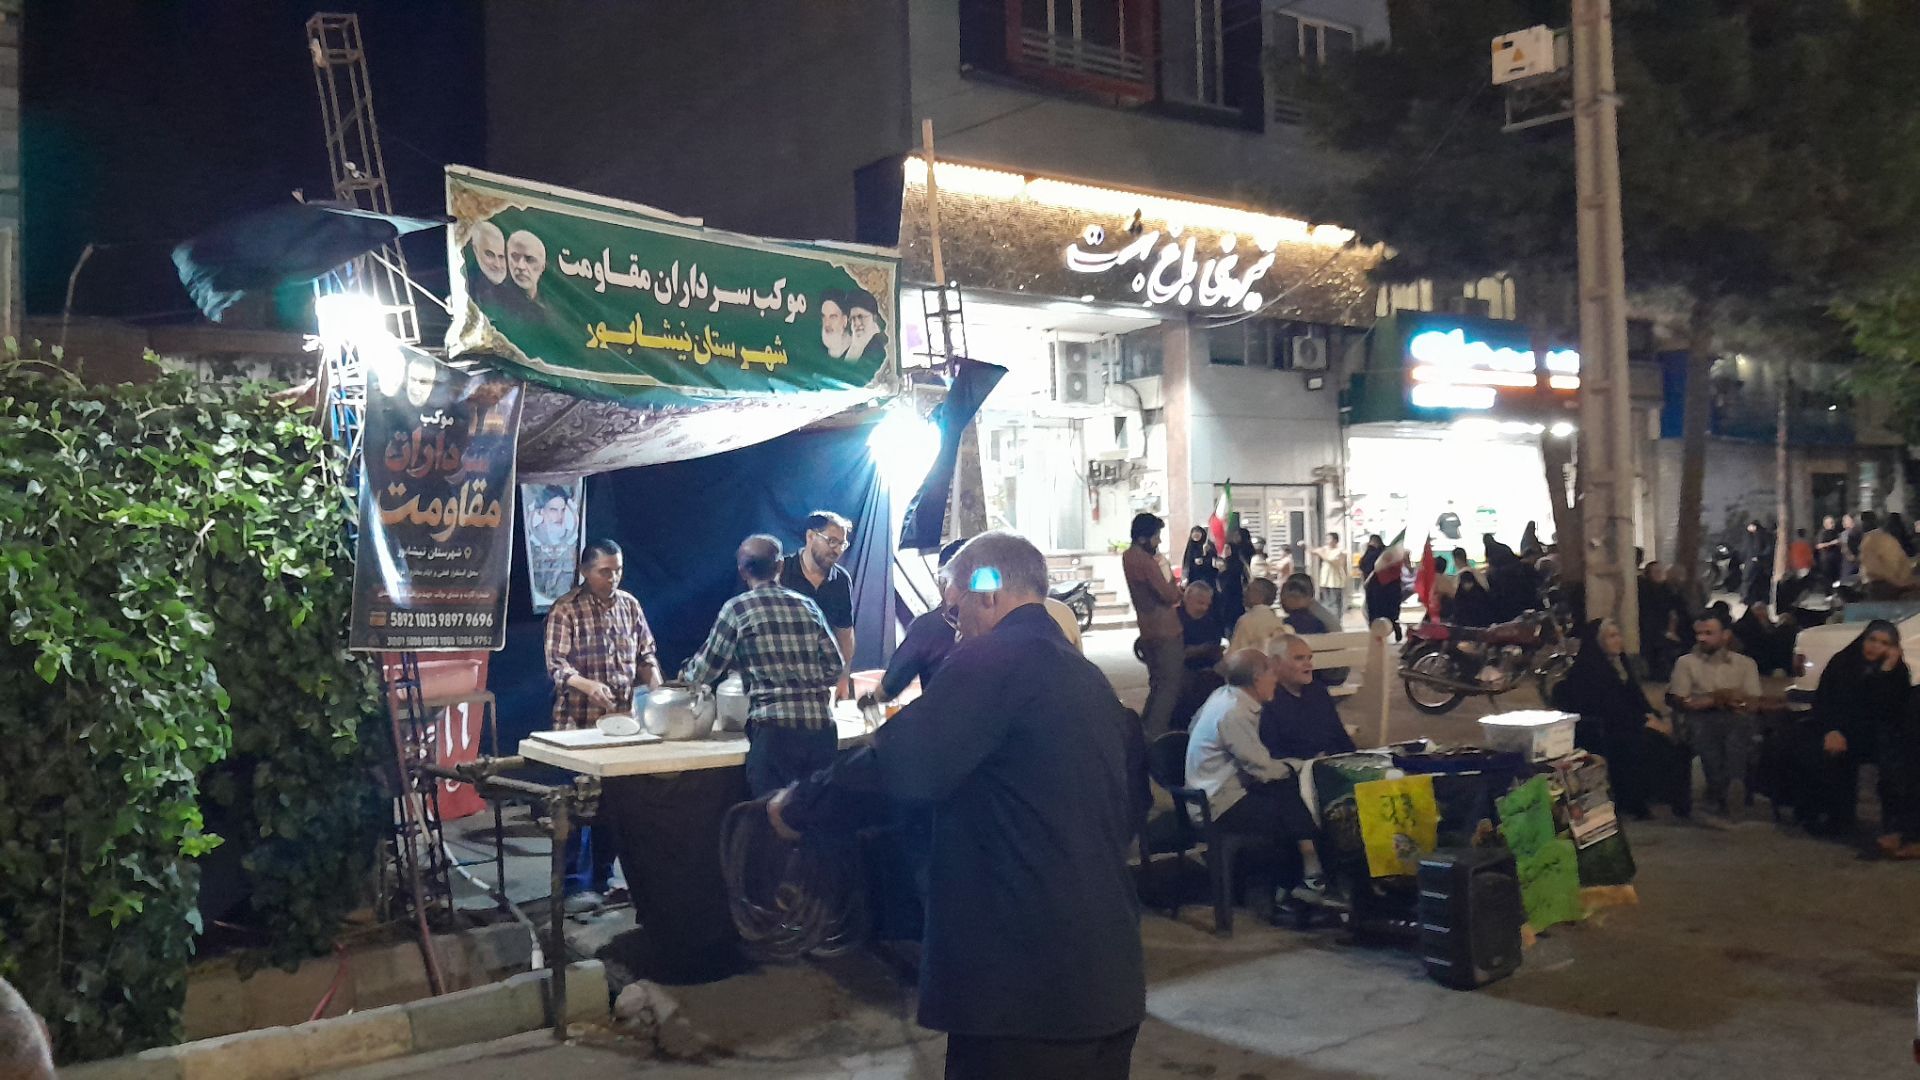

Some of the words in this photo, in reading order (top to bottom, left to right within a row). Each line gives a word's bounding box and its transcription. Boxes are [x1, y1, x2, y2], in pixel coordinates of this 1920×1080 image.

[557, 247, 652, 293] مقاومت
[653, 259, 752, 313] سرداران
[751, 278, 808, 324] موکب
[585, 312, 693, 361] نیشابور
[693, 325, 789, 371] شهرستان
[419, 409, 454, 430] موکب
[376, 479, 502, 542] مقاومت
[427, 546, 462, 560] شهرستان
[390, 612, 414, 627] 5892
[415, 613, 437, 627] 1013
[438, 613, 464, 627] 9897
[465, 613, 493, 627] 9696
